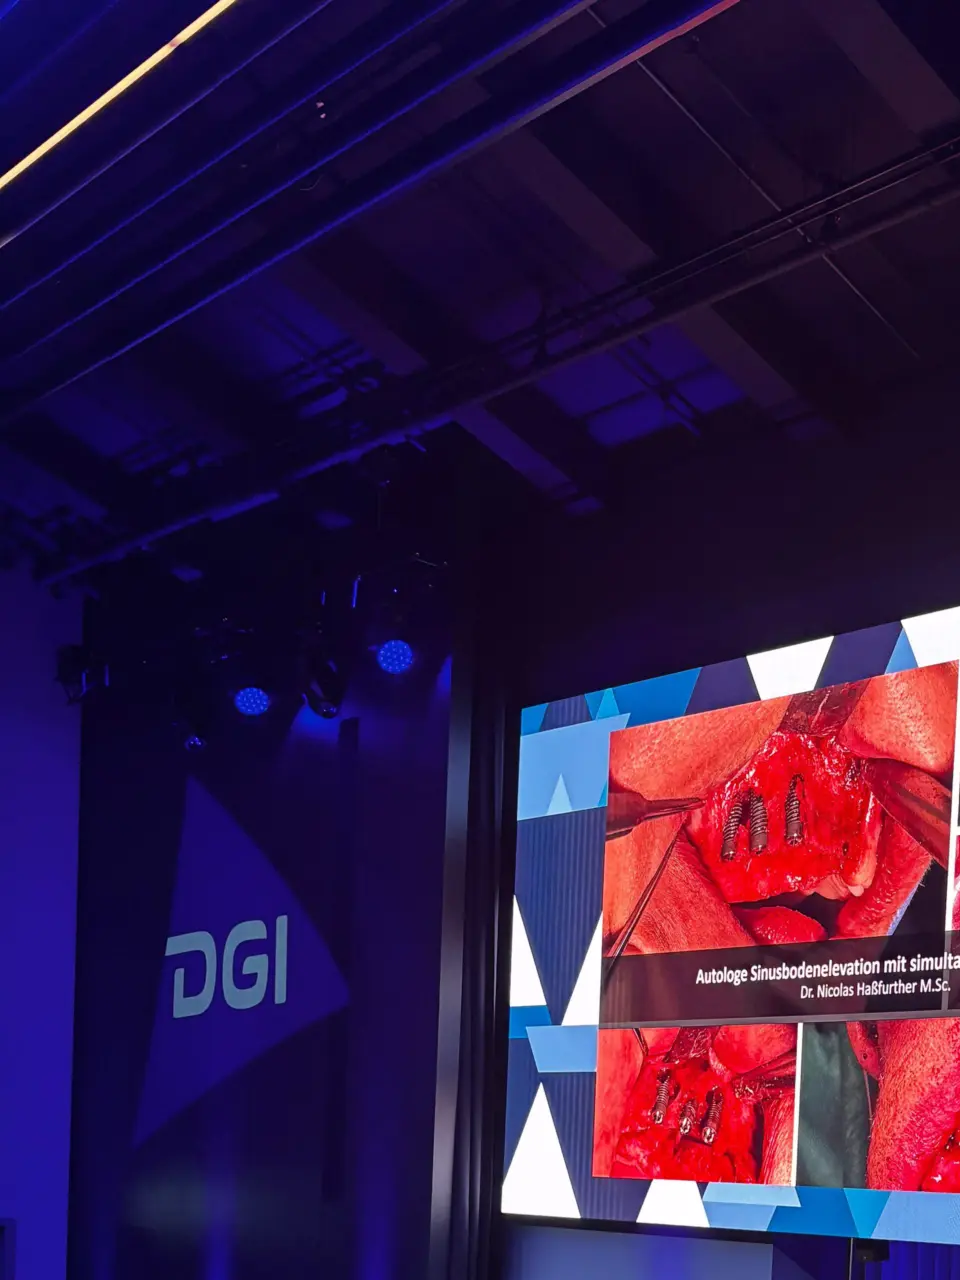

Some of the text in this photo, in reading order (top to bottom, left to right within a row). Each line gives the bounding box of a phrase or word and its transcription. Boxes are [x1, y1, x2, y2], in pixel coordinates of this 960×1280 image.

[164, 914, 289, 1019] DGI
[695, 965, 748, 986] Autologe
[750, 958, 881, 982] Sinusbodenelevation
[883, 954, 907, 974] mit
[800, 977, 951, 999] Dr. Nicolas Haßfurther M.Sc.
